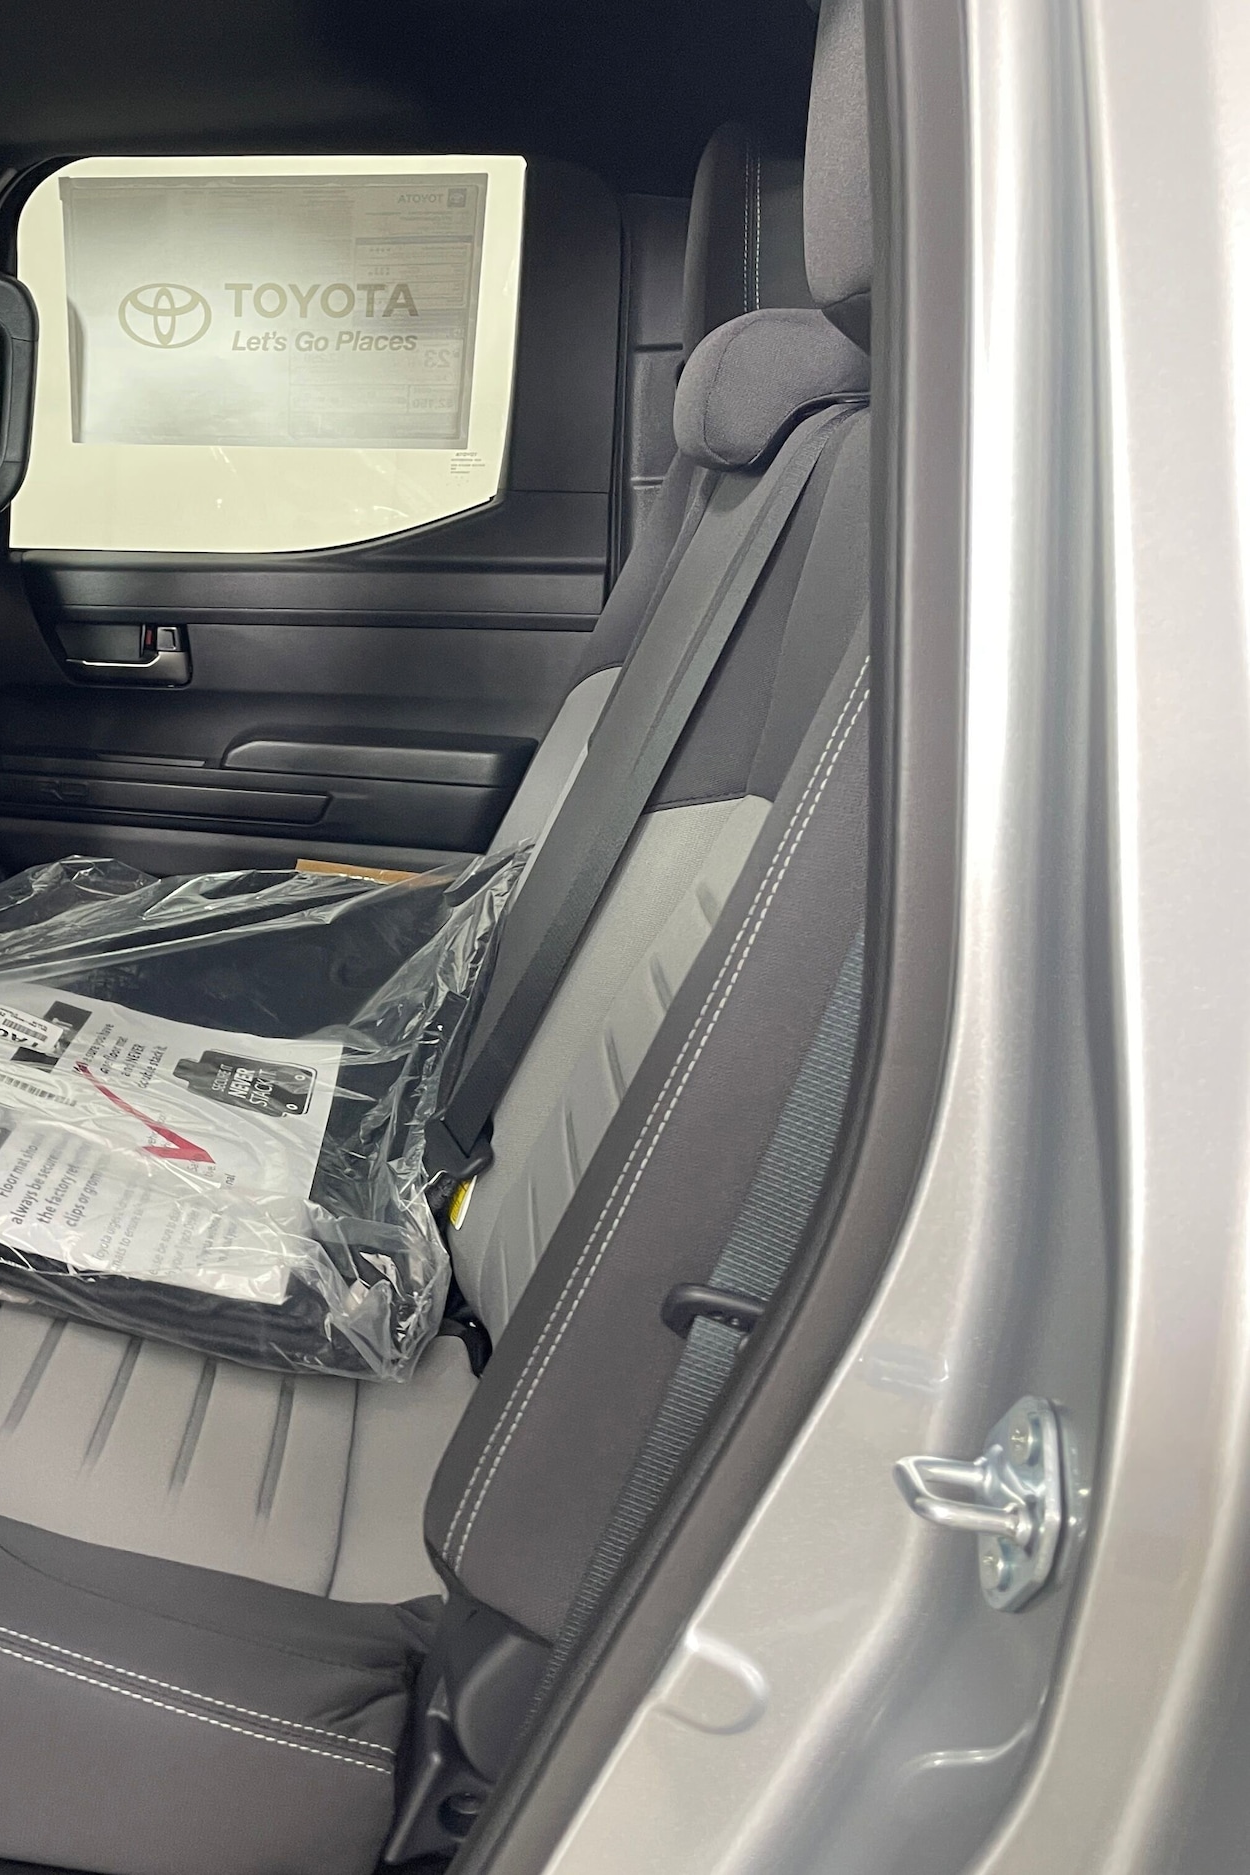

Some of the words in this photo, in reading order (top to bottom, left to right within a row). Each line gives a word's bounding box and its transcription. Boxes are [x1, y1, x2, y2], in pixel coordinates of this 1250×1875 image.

[224, 282, 419, 319] TOYOTA
[232, 330, 288, 352] Let's
[295, 331, 329, 352] Go
[335, 331, 419, 352] Places
[126, 1043, 146, 1063] NEVER
[211, 1069, 232, 1093] SECURE
[220, 1063, 234, 1072] IT
[227, 1067, 256, 1099] NEVER
[249, 1077, 275, 1107] STACK
[14, 1156, 29, 1175] mat
[10, 1189, 39, 1225] always
[27, 1176, 45, 1192] be
[45, 1173, 78, 1208] factory
[36, 1205, 57, 1225] the
[62, 1202, 87, 1228] clips
[78, 1191, 92, 1205] or
